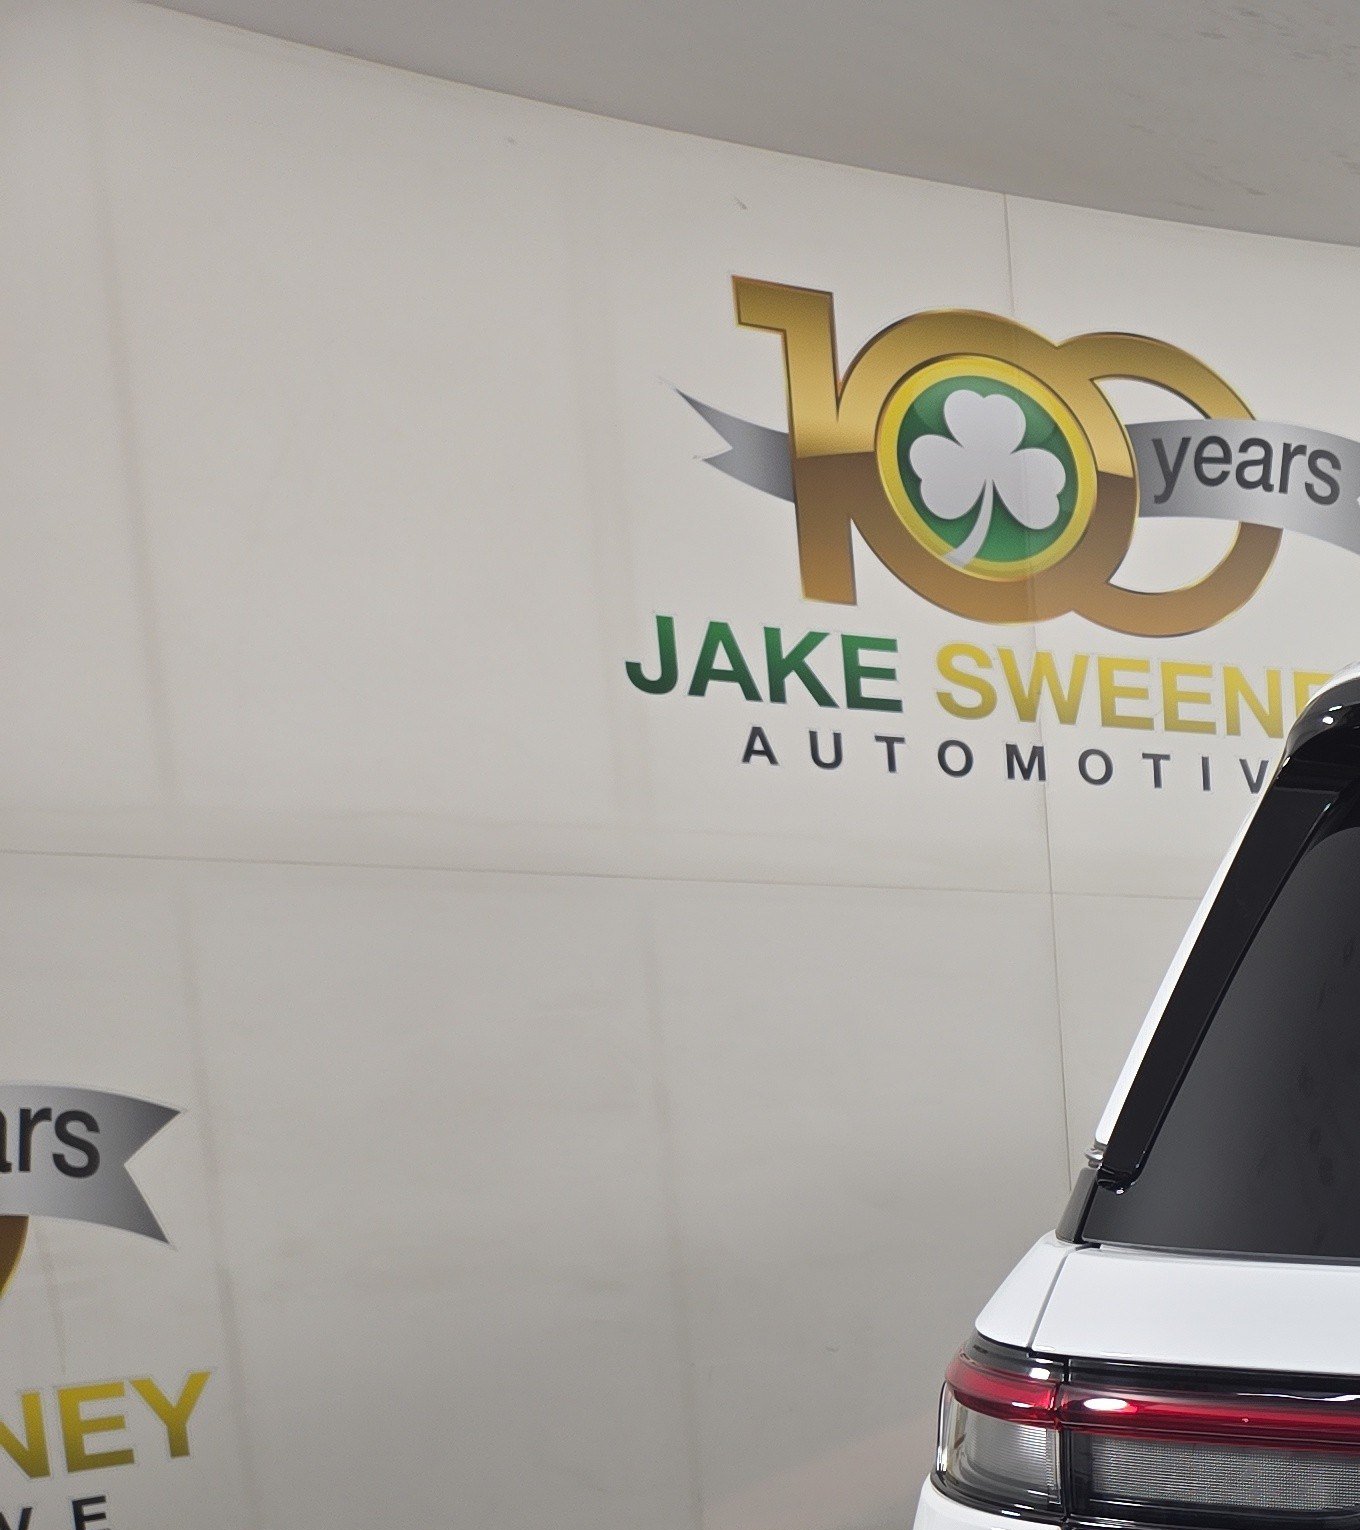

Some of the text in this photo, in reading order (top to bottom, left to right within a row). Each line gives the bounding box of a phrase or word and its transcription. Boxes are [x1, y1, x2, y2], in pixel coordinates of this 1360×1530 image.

[732, 275, 1343, 637] 100 years
[626, 615, 903, 713] JAKE
[742, 726, 1270, 794] AUTOMOTIV
[0, 1107, 100, 1178] rs
